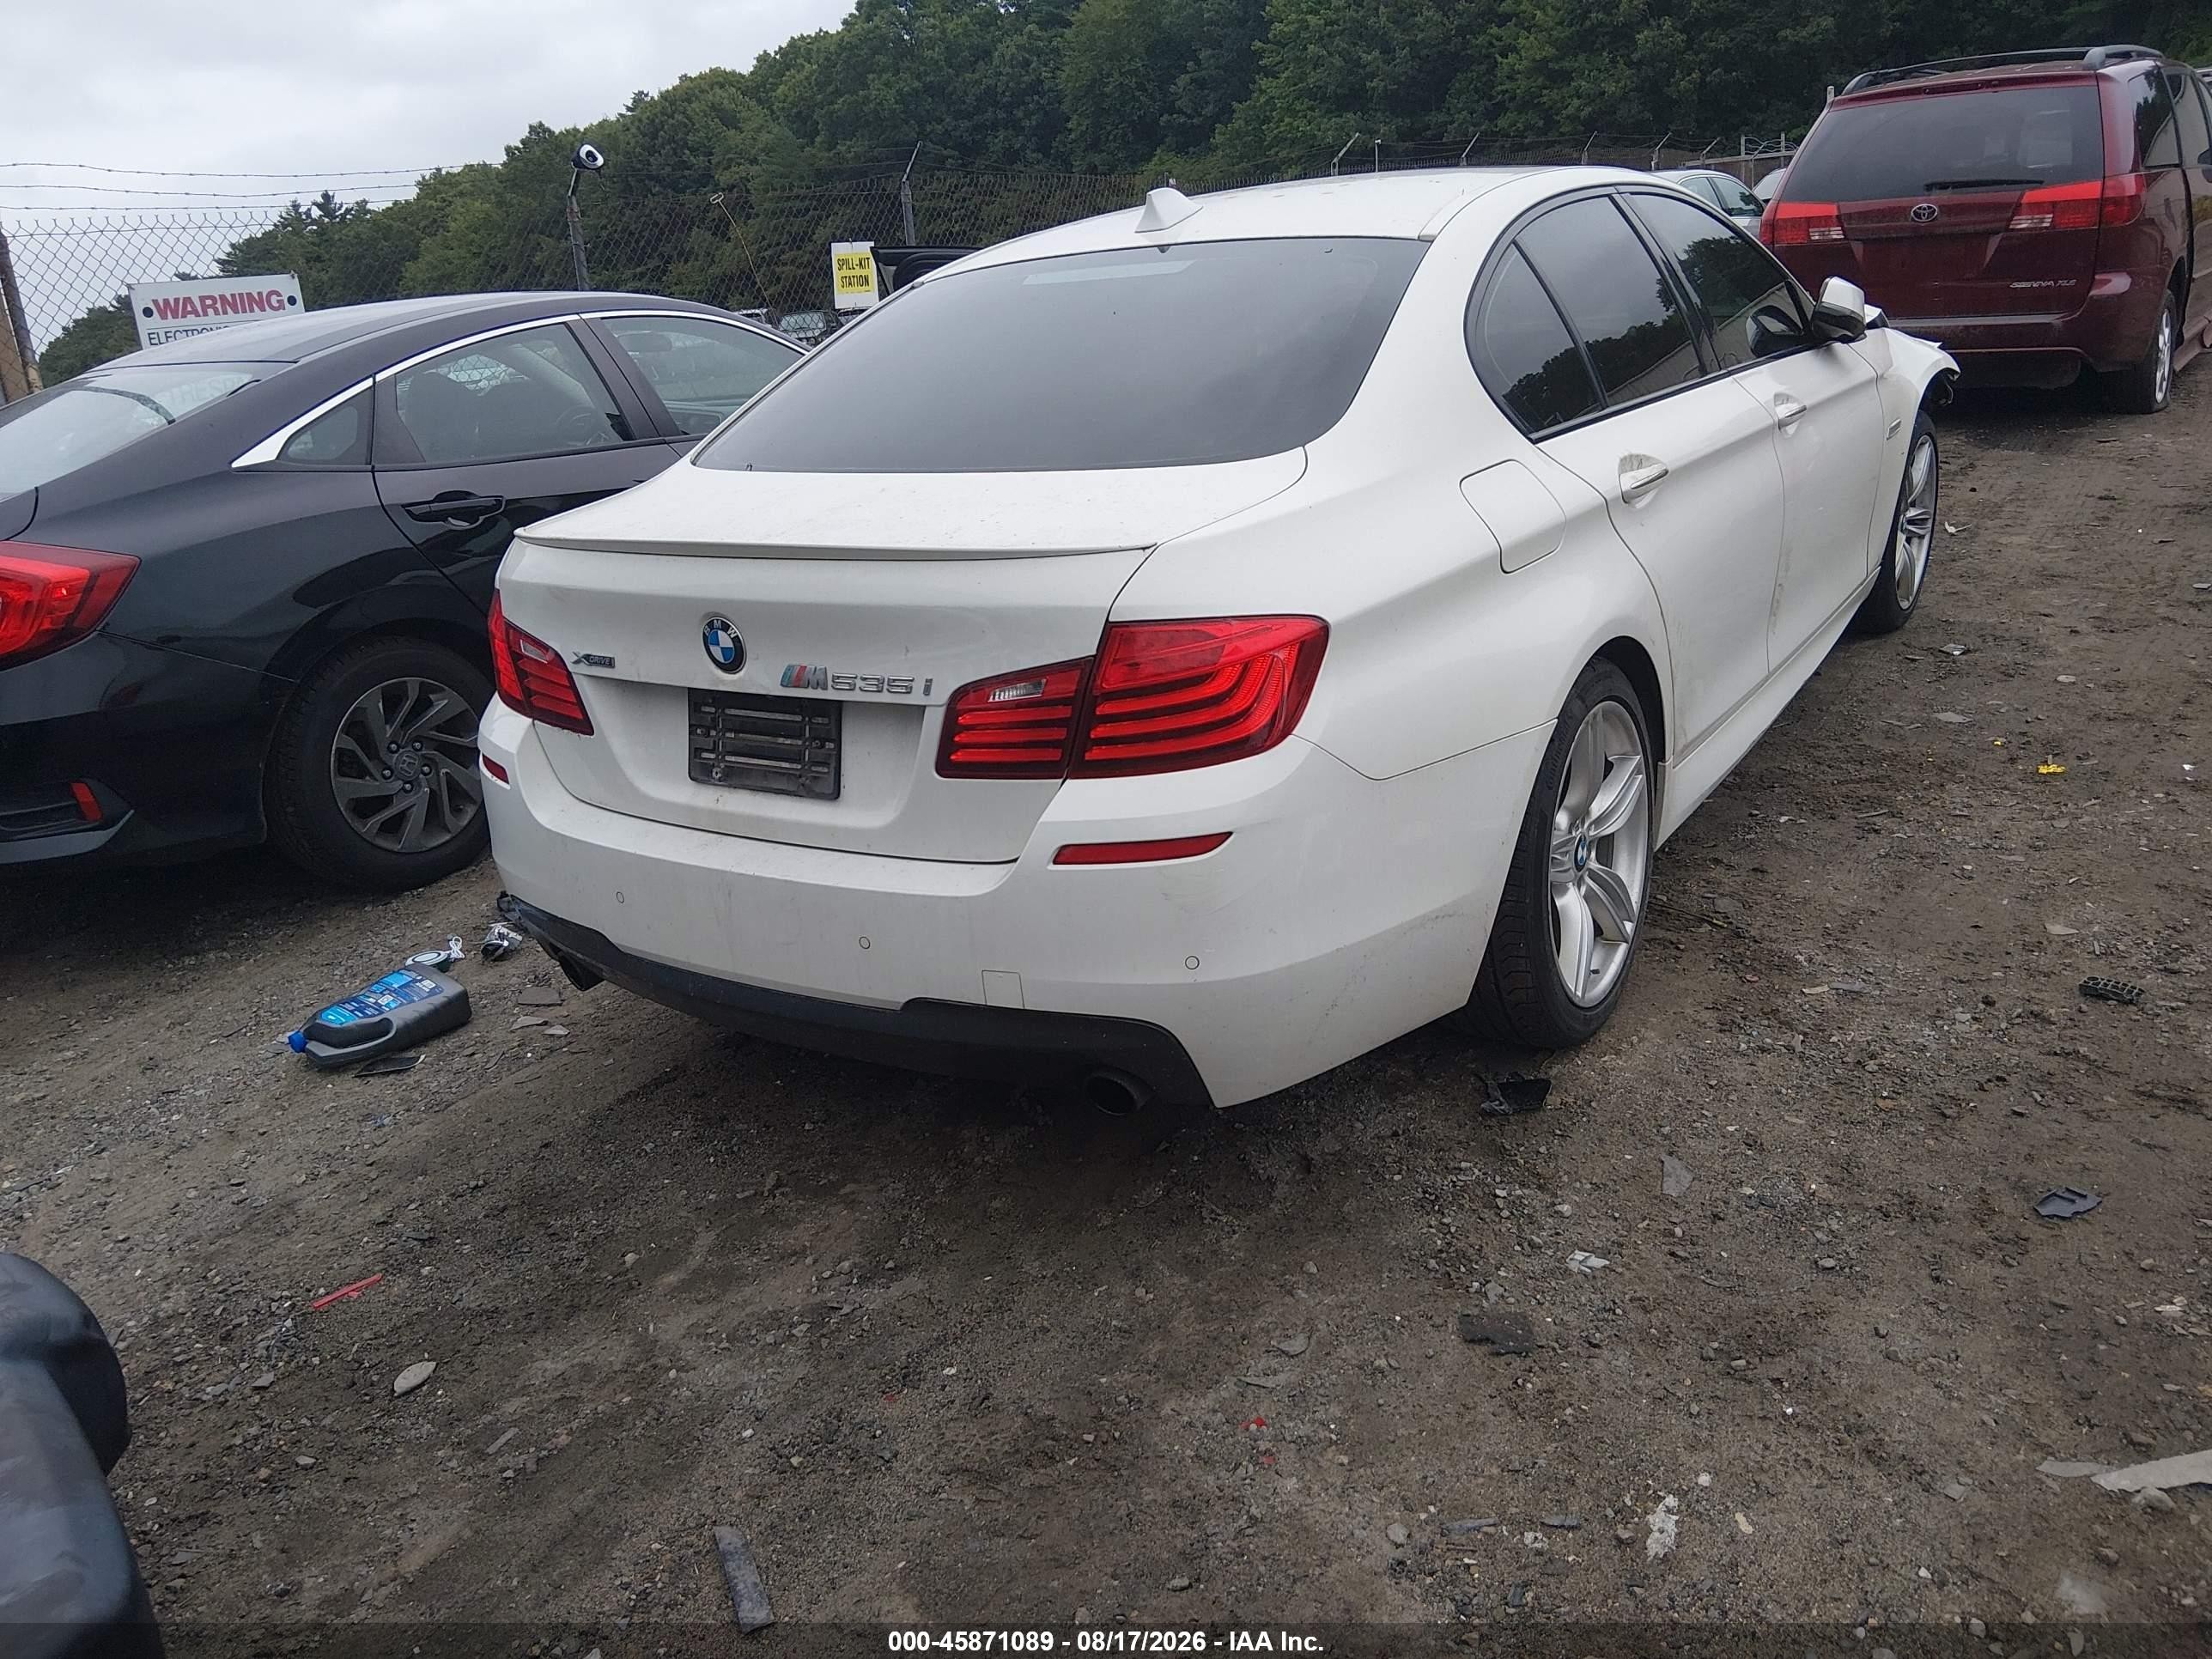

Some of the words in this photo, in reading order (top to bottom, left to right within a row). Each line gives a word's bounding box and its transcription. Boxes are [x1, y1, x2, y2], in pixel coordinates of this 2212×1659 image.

[837, 257, 871, 270] SPILL-KIT
[841, 274, 870, 289] STATION
[151, 289, 286, 321] WARNING
[148, 325, 230, 345] ELECT
[704, 619, 738, 638] BMW
